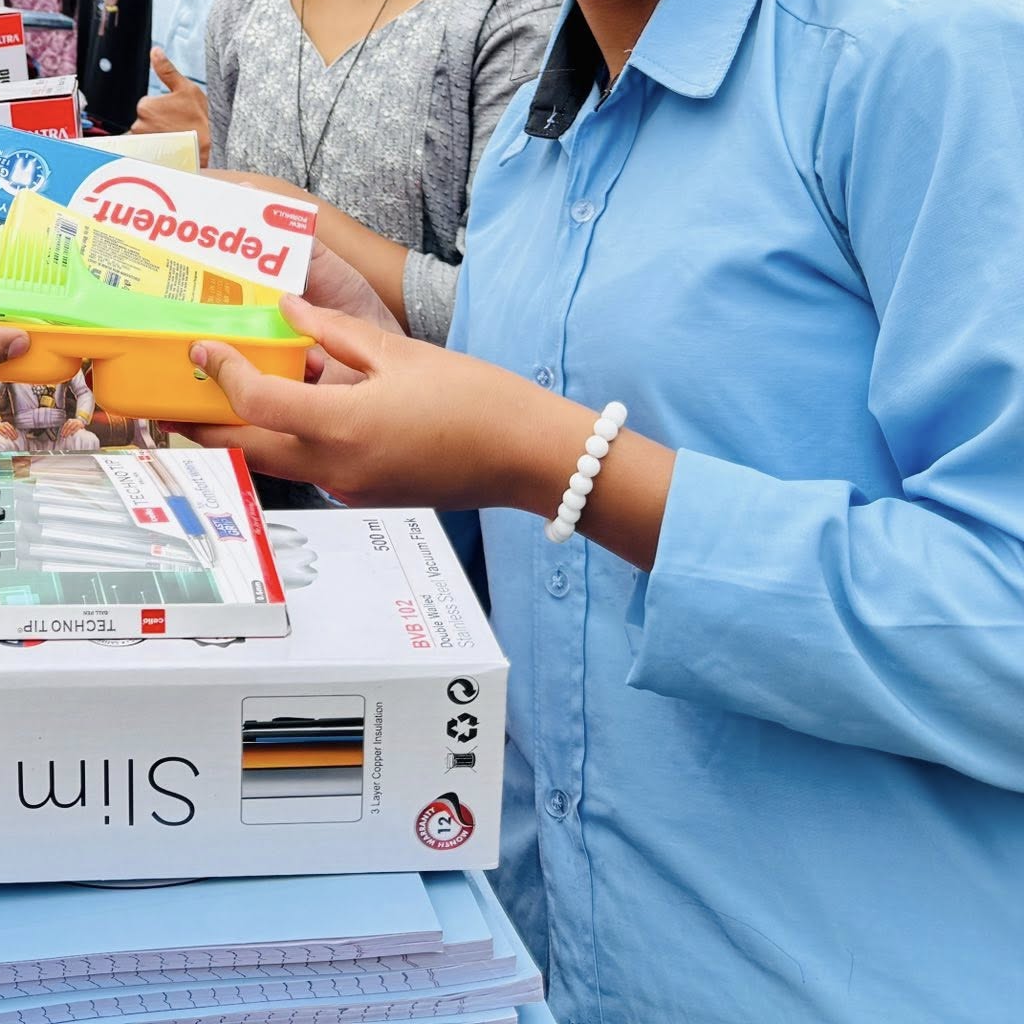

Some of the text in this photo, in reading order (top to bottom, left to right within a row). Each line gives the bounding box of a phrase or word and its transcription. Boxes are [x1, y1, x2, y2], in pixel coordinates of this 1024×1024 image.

[0, 202, 9, 212] Y
[93, 200, 290, 276] Pepsodent
[114, 470, 149, 505] TECHNO
[362, 519, 389, 551] 500 ml
[403, 517, 441, 578] Vacuum Flask
[52, 619, 116, 633] TECHNO
[142, 617, 164, 626] cello
[395, 600, 431, 648] BVB 102
[420, 594, 453, 648] Double Walled
[431, 579, 475, 648] Stainless Steel
[373, 702, 384, 745] Insulation
[372, 748, 384, 779] Copper
[17, 756, 200, 826] Slim
[372, 779, 382, 805] Layer
[418, 806, 469, 848] MONTH WARRANTY
[438, 817, 451, 834] 12
